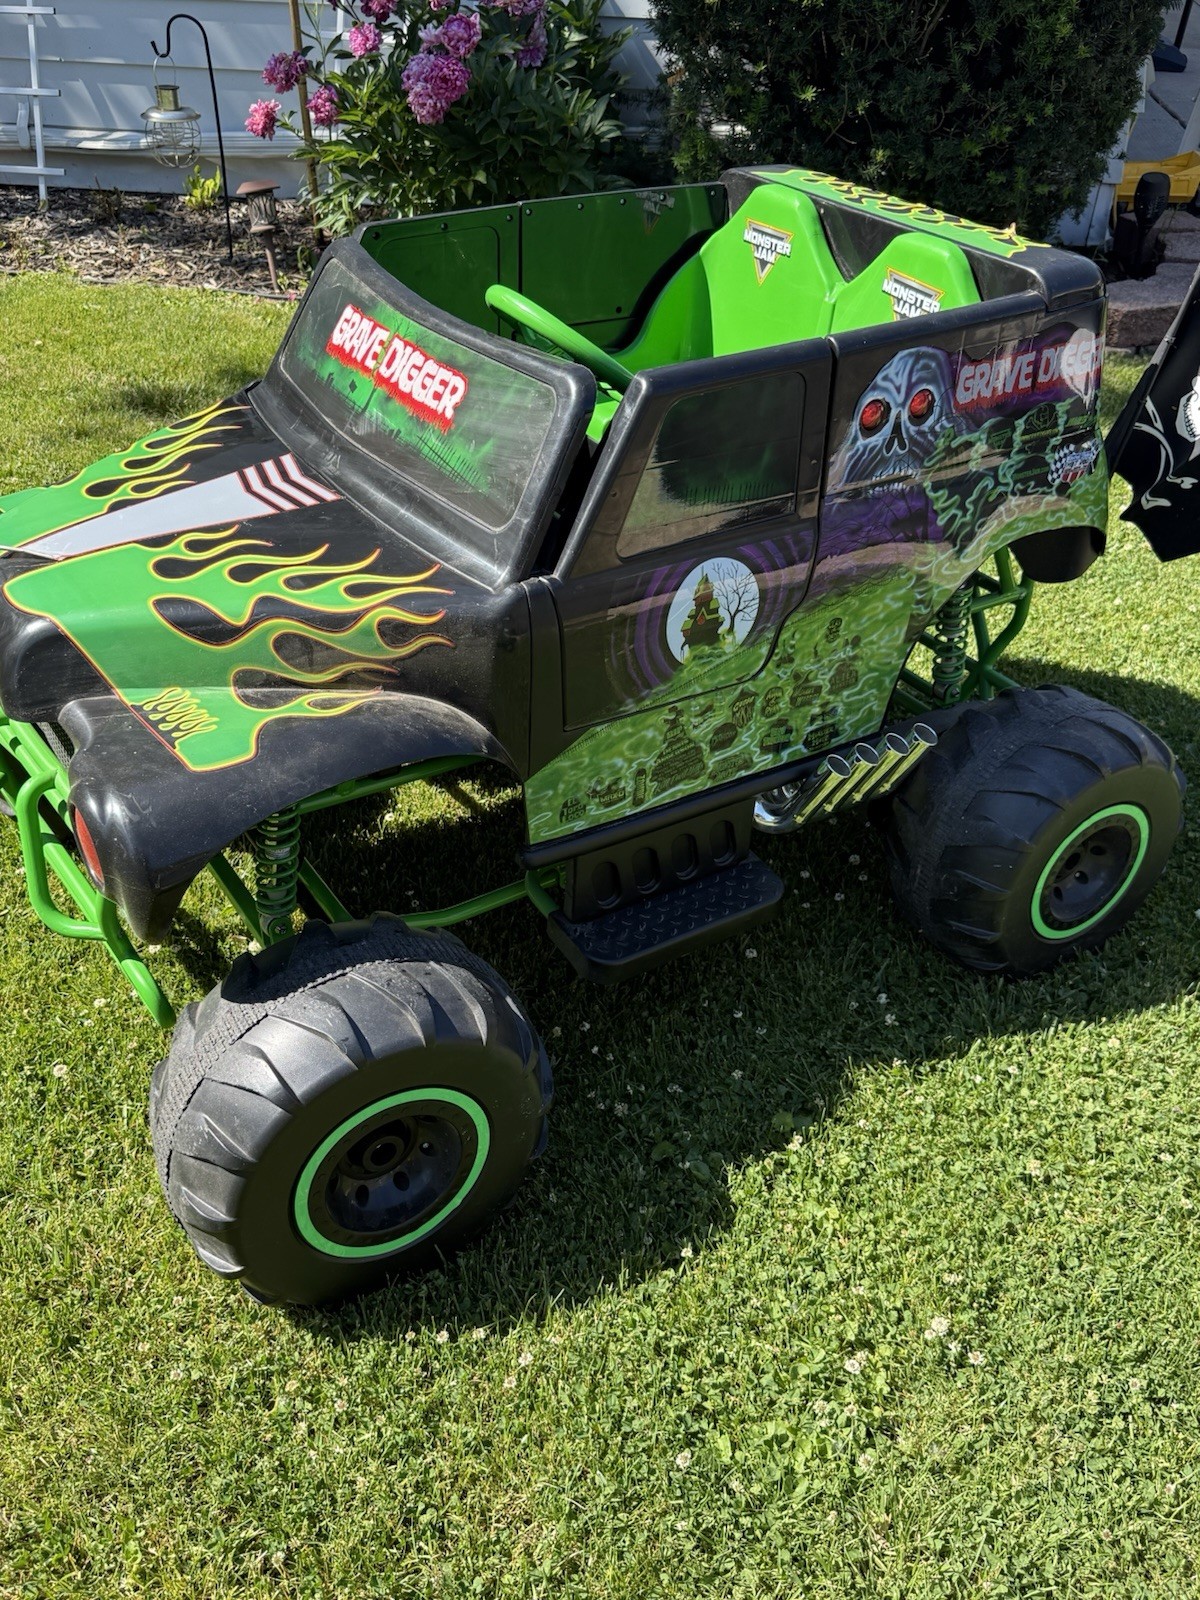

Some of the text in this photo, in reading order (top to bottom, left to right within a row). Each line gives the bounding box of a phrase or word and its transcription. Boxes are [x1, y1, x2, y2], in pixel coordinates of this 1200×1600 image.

[743, 228, 791, 257] MONSTER
[754, 245, 777, 264] JAM
[882, 279, 941, 313] MONSTER
[894, 300, 923, 319] JAM
[331, 304, 467, 420] GRAVE DIGGER
[955, 351, 1036, 405] GRAVE
